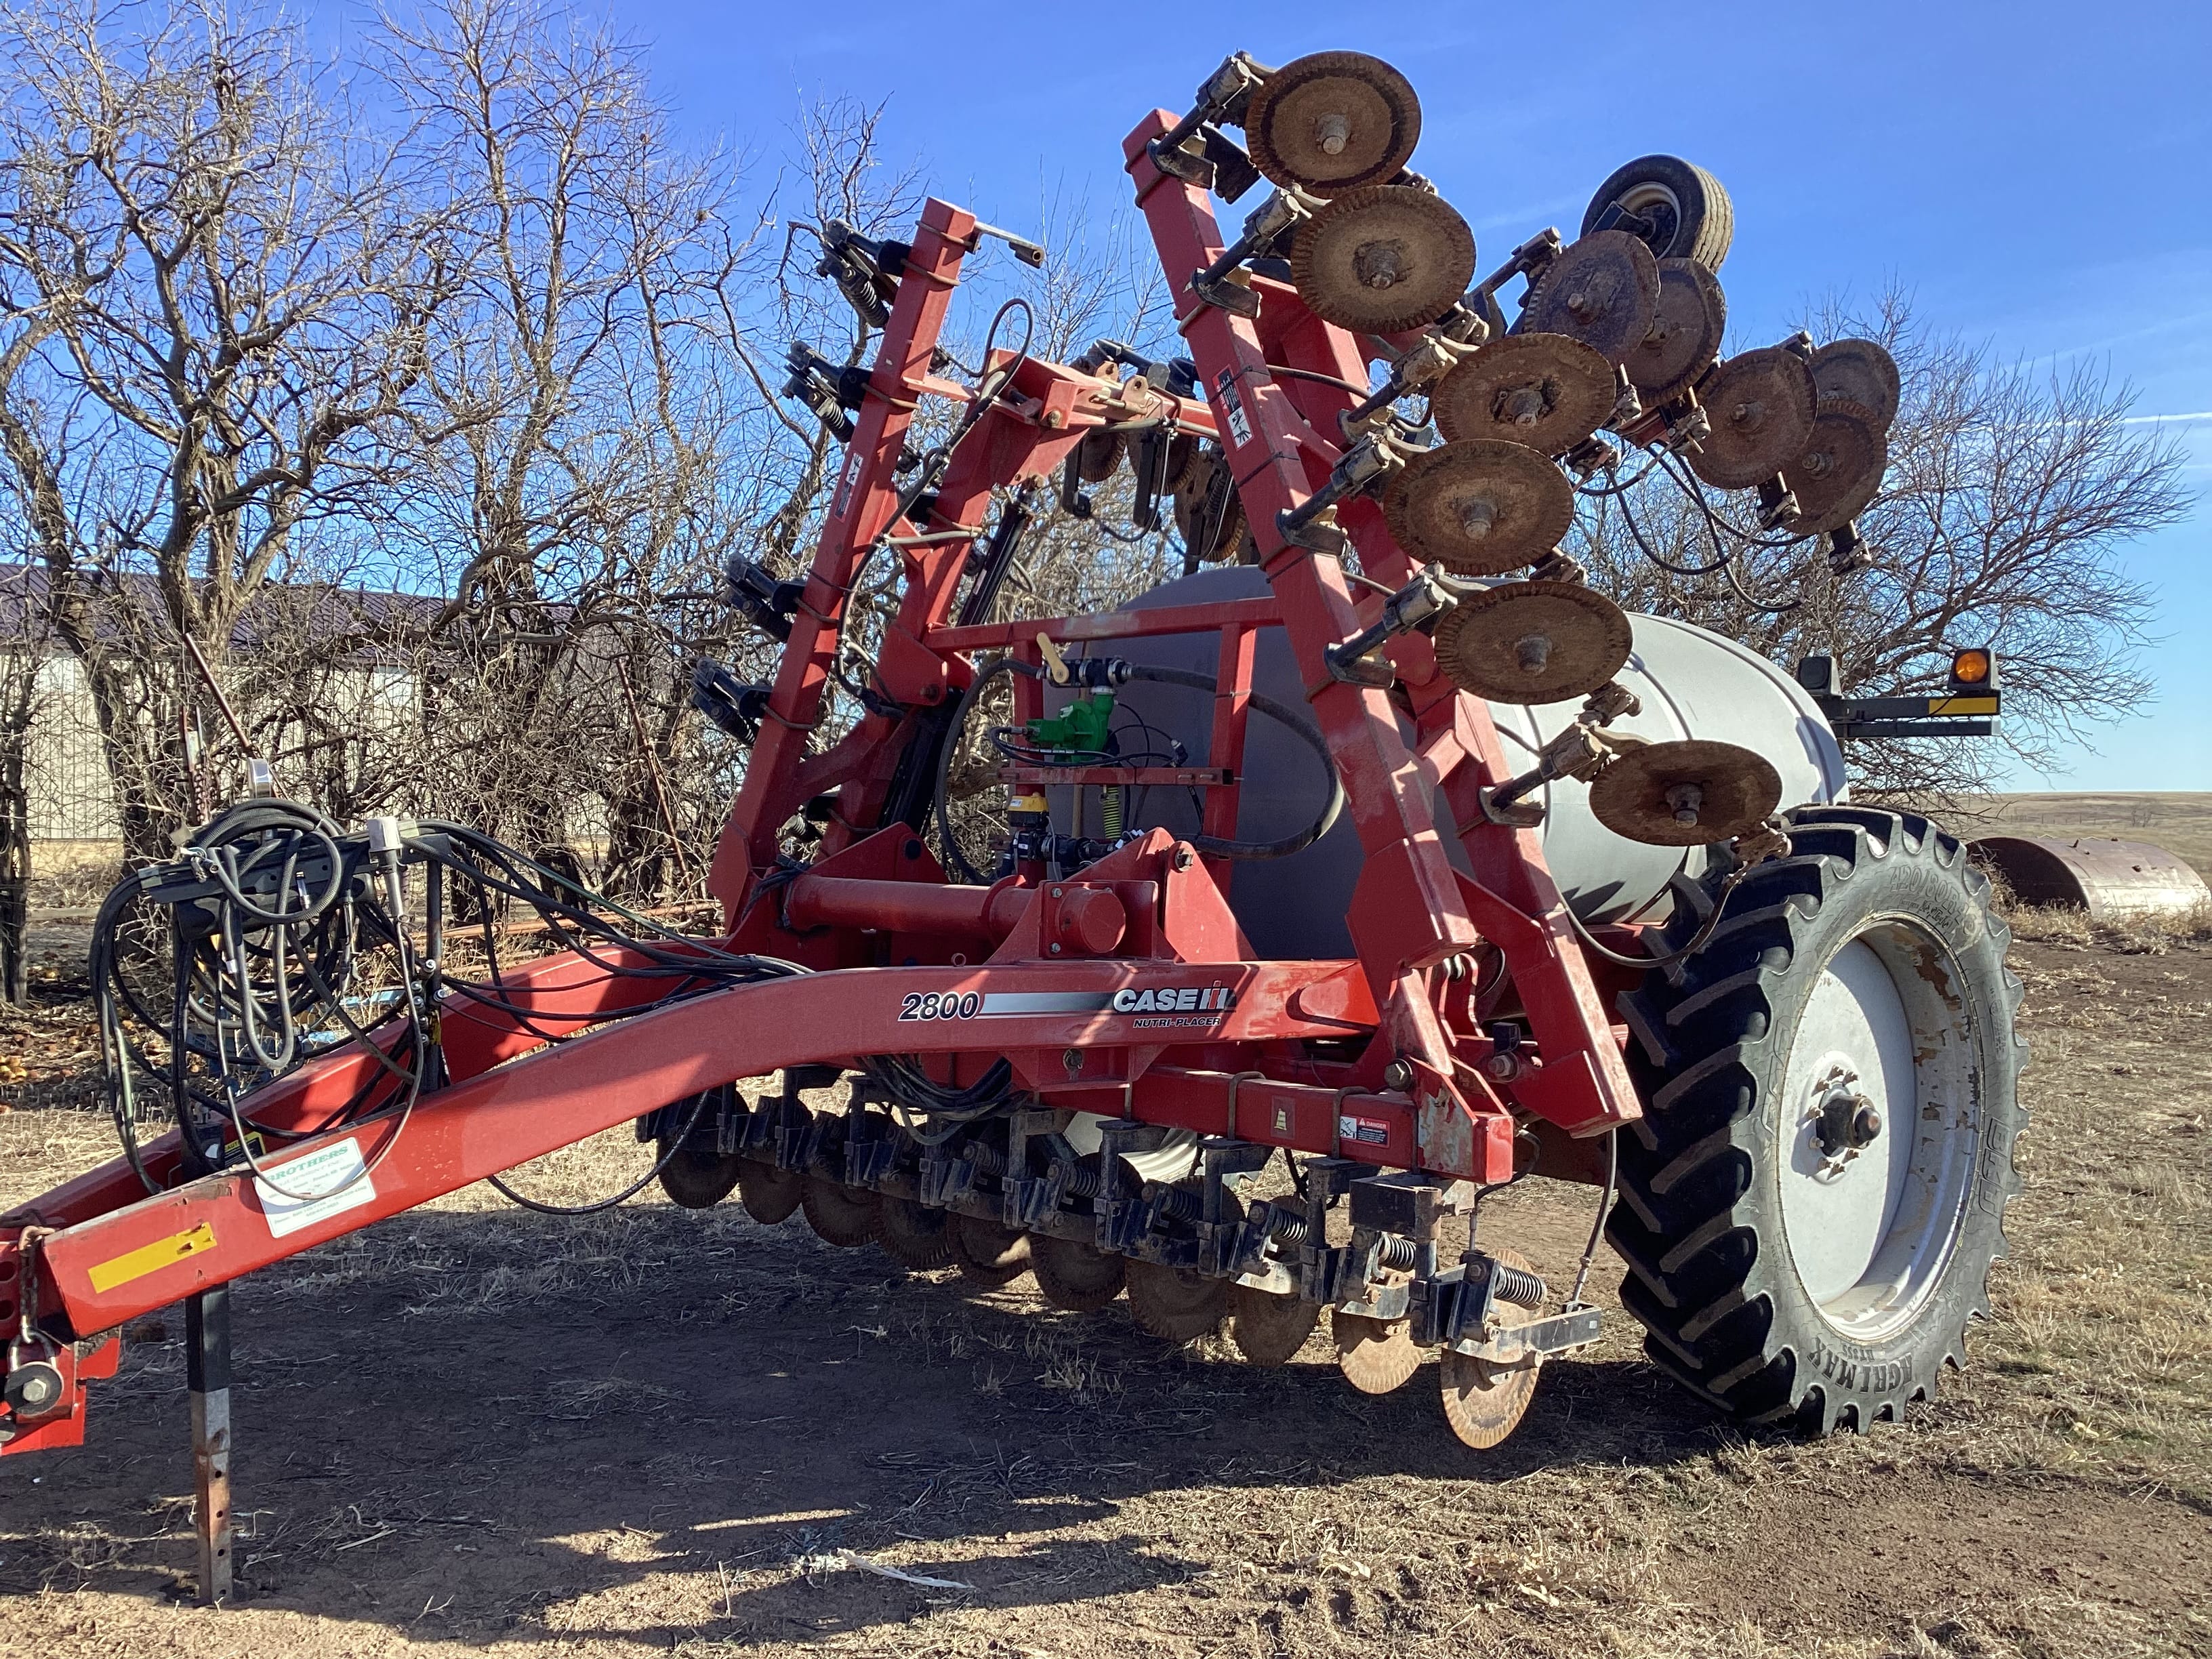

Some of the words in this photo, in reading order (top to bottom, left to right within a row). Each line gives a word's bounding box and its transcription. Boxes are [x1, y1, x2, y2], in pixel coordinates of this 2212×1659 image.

[897, 991, 980, 1022] 2800
[1132, 1017, 1222, 1029] NUTRI-PLACER
[1806, 1336, 1912, 1394] AGRIMAX
